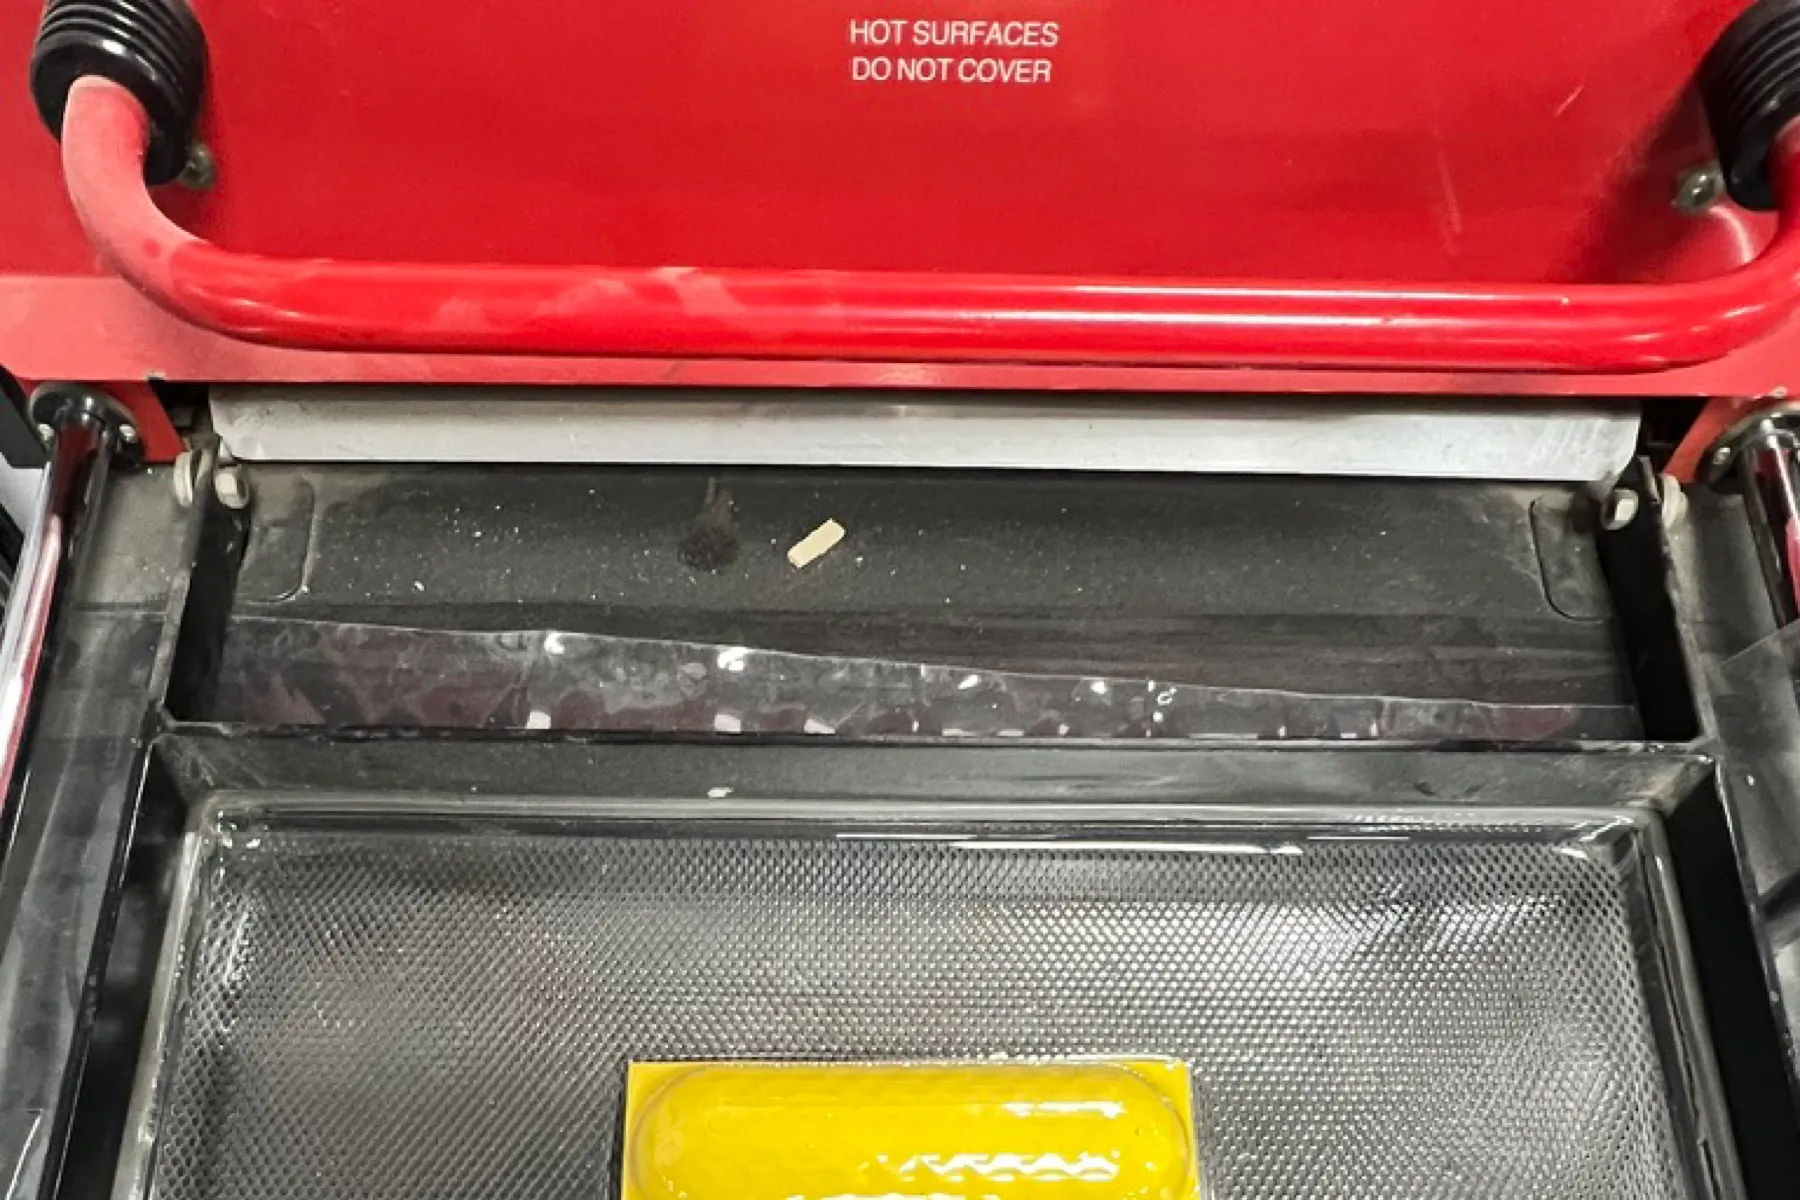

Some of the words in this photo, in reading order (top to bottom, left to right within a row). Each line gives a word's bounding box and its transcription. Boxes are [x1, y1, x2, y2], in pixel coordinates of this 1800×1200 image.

[850, 19, 907, 45] HOT
[913, 20, 1060, 47] SURFACES
[852, 56, 891, 81] DO
[897, 57, 953, 82] NOT
[958, 58, 1052, 83] COVER
